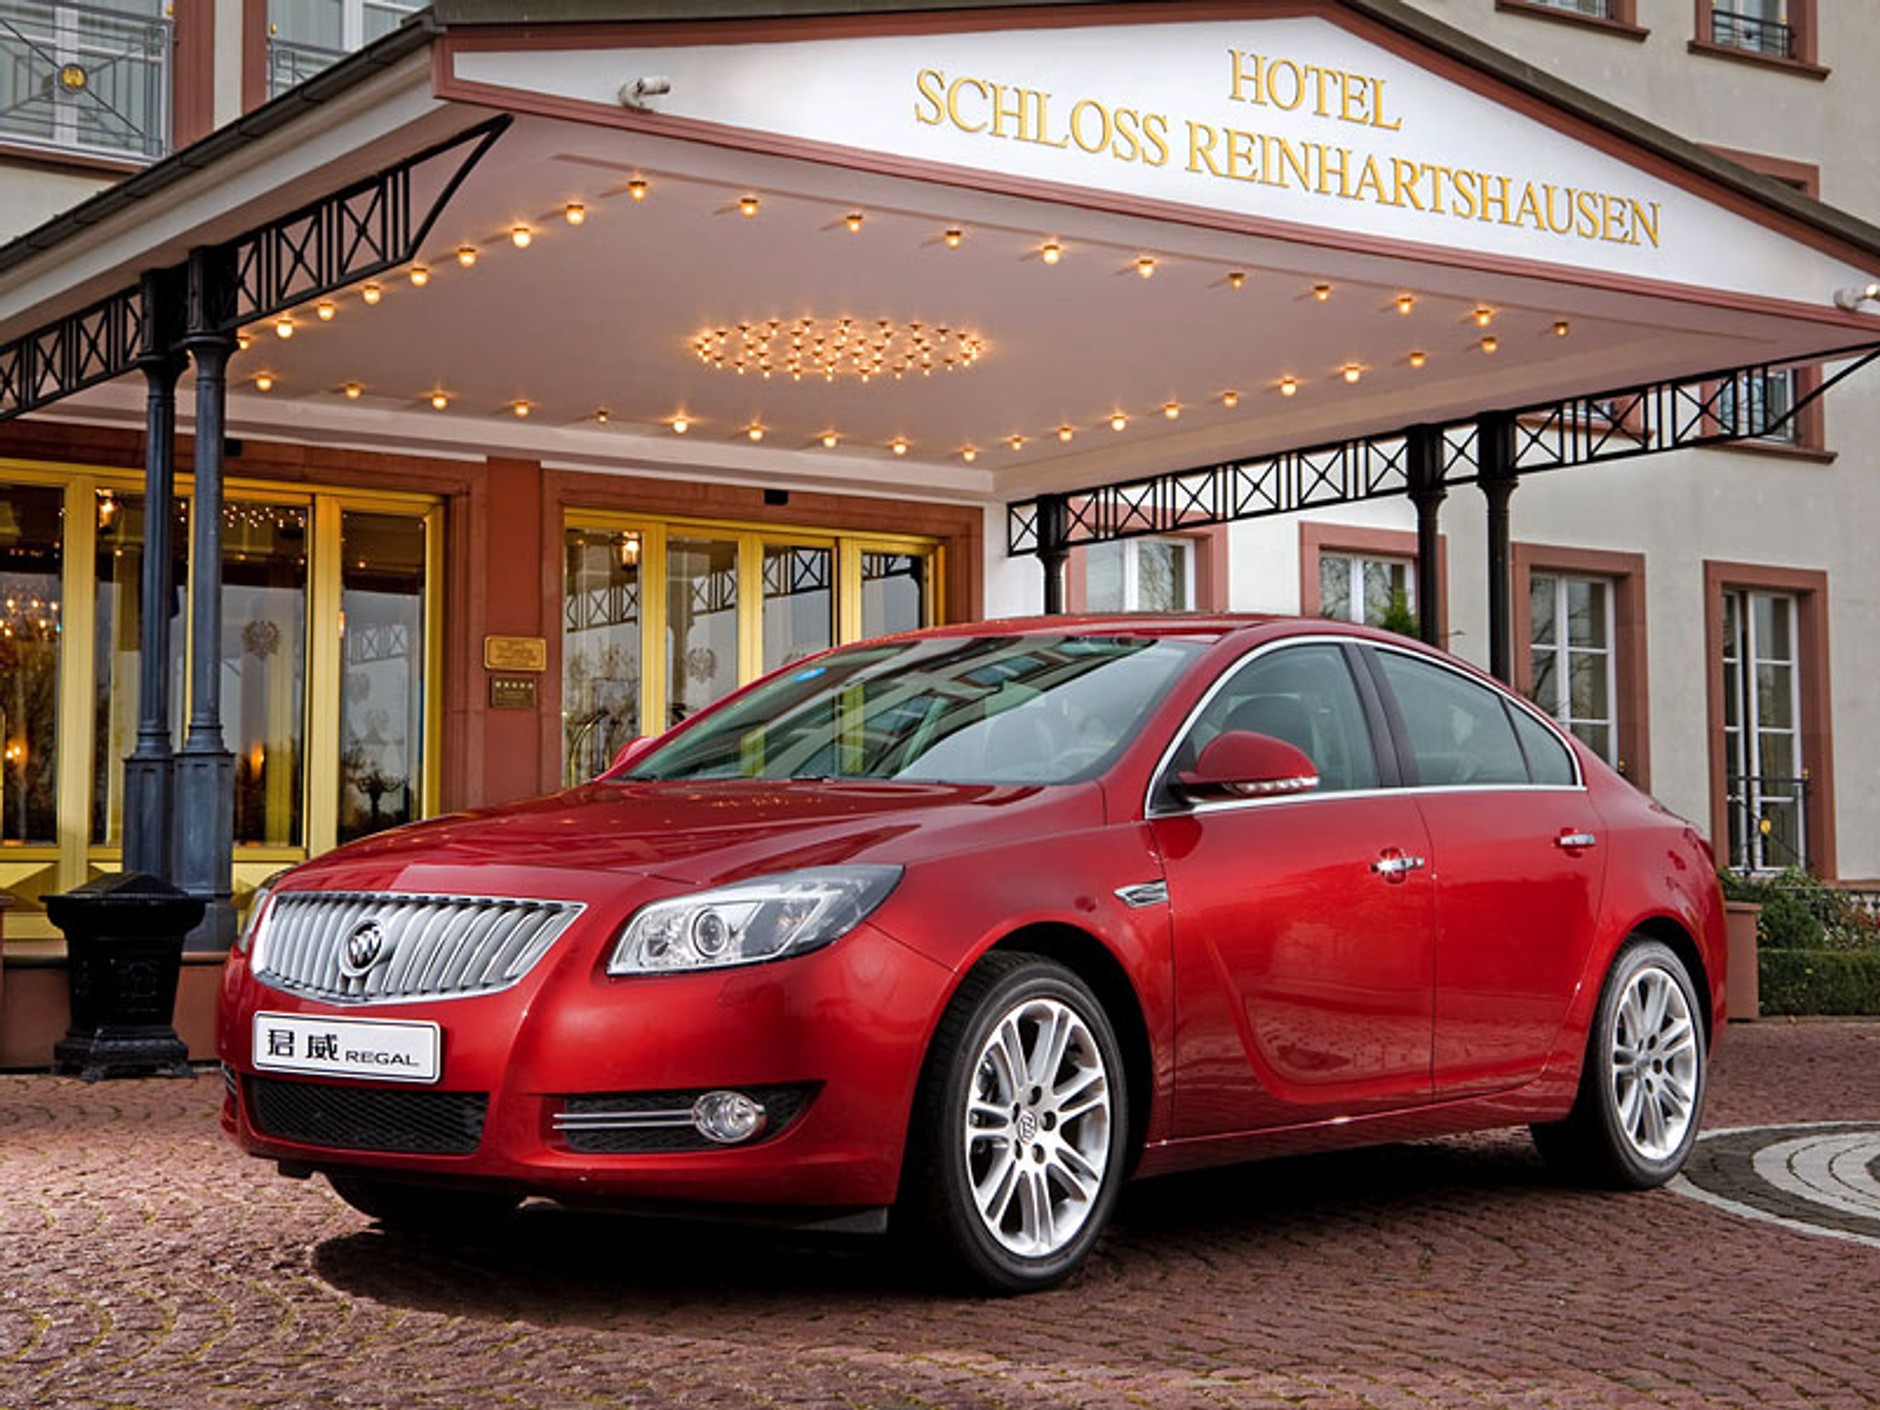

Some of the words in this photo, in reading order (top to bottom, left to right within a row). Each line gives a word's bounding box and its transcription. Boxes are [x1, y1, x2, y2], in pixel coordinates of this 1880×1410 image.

[1227, 48, 1402, 131] HOTEL
[914, 69, 1170, 166] SCHLOSS
[1184, 119, 1662, 249] REINHARTSHAUSEN
[345, 1050, 420, 1066] REGAL
